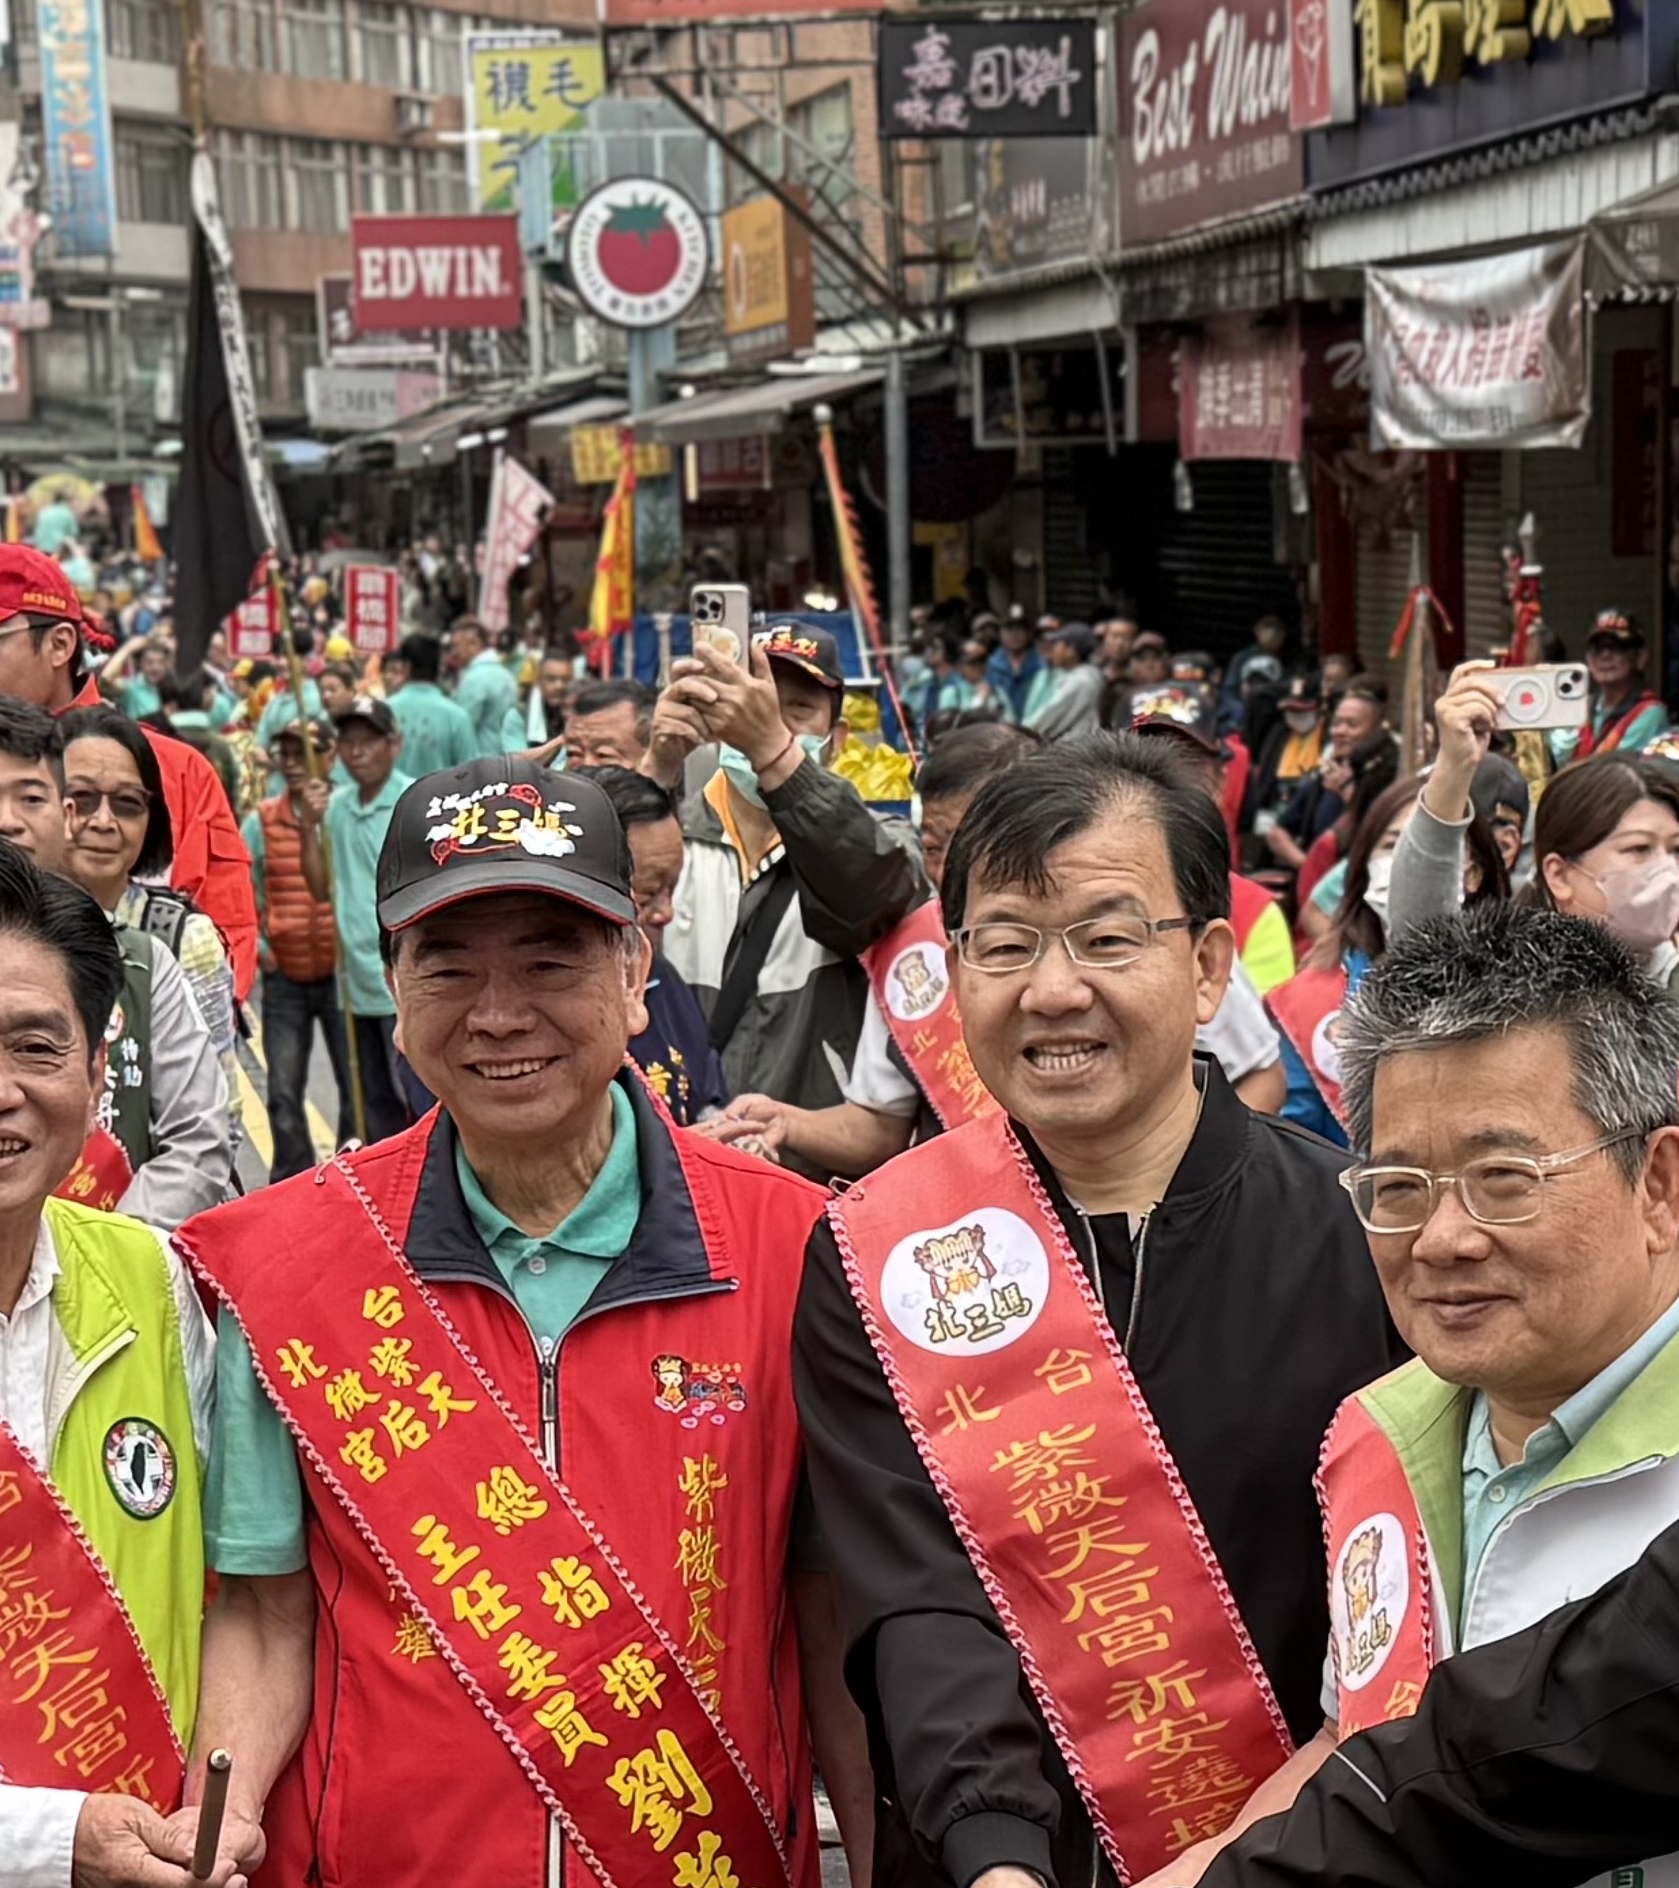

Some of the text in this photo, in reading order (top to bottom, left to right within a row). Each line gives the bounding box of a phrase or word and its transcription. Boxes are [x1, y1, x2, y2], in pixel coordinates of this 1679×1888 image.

[1133, 28, 1197, 165] Best
[360, 246, 502, 299] EDWIN
[924, 1282, 1033, 1343] 北三媽
[415, 1513, 610, 1767] 主任委員
